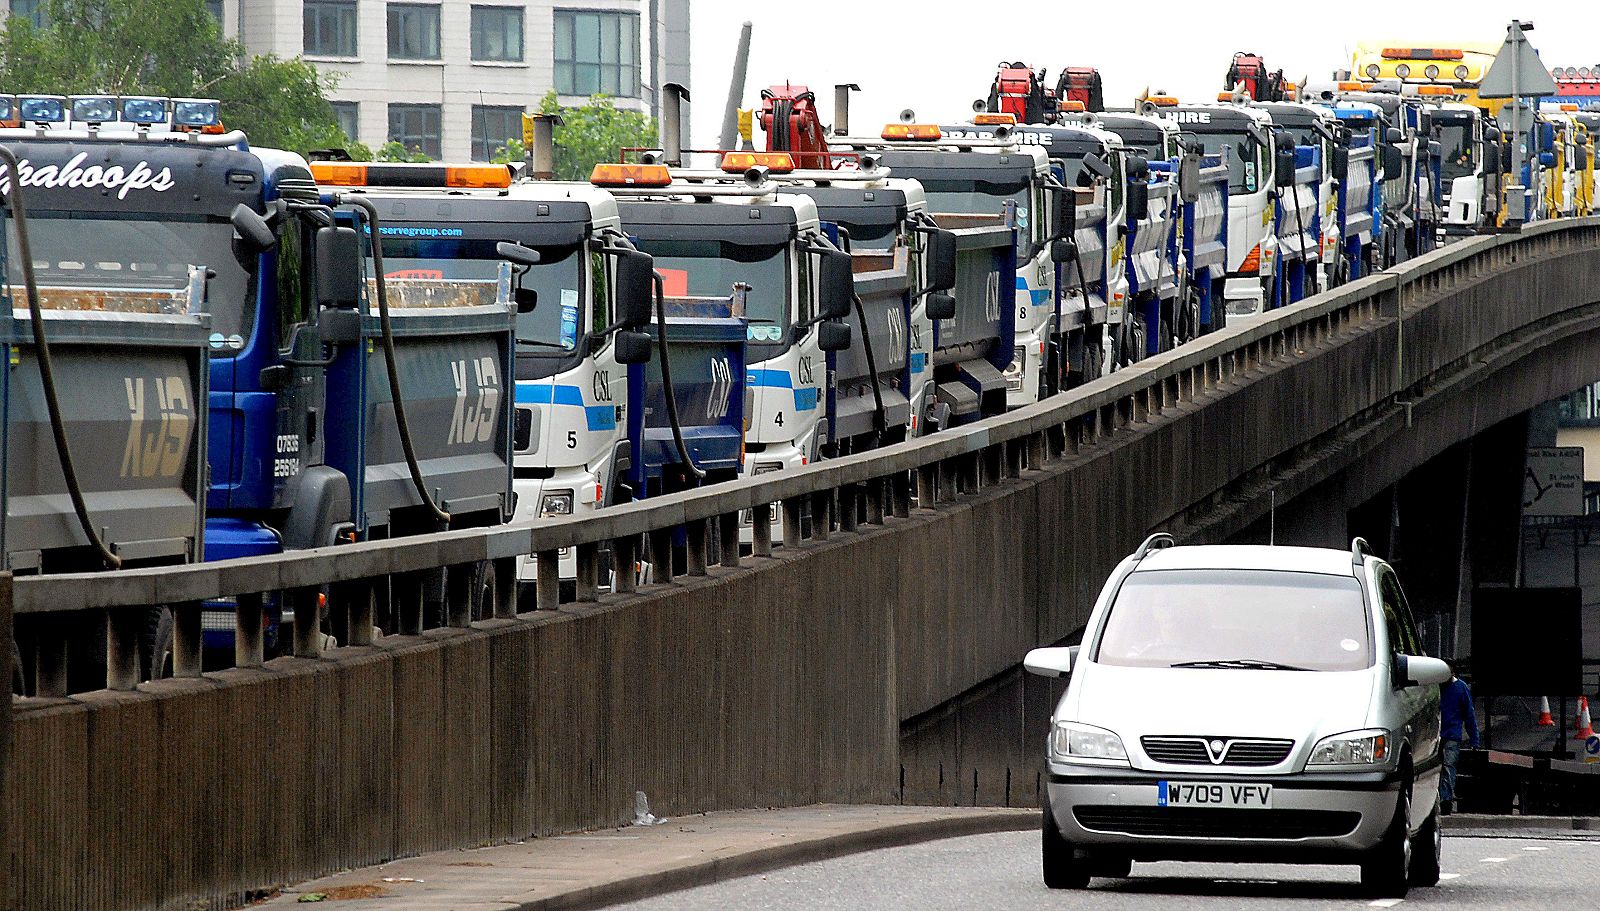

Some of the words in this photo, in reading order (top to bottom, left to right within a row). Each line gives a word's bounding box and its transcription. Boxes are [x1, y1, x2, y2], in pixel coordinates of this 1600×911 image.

[1166, 111, 1211, 124] HIRE
[1019, 306, 1027, 319] 8
[798, 356, 814, 385] CSL
[593, 370, 613, 402] CSL
[706, 357, 732, 419] CSL
[774, 411, 784, 427] 4
[567, 430, 577, 449] 5
[1168, 784, 1223, 804] W709
[1229, 785, 1270, 805] VFV
